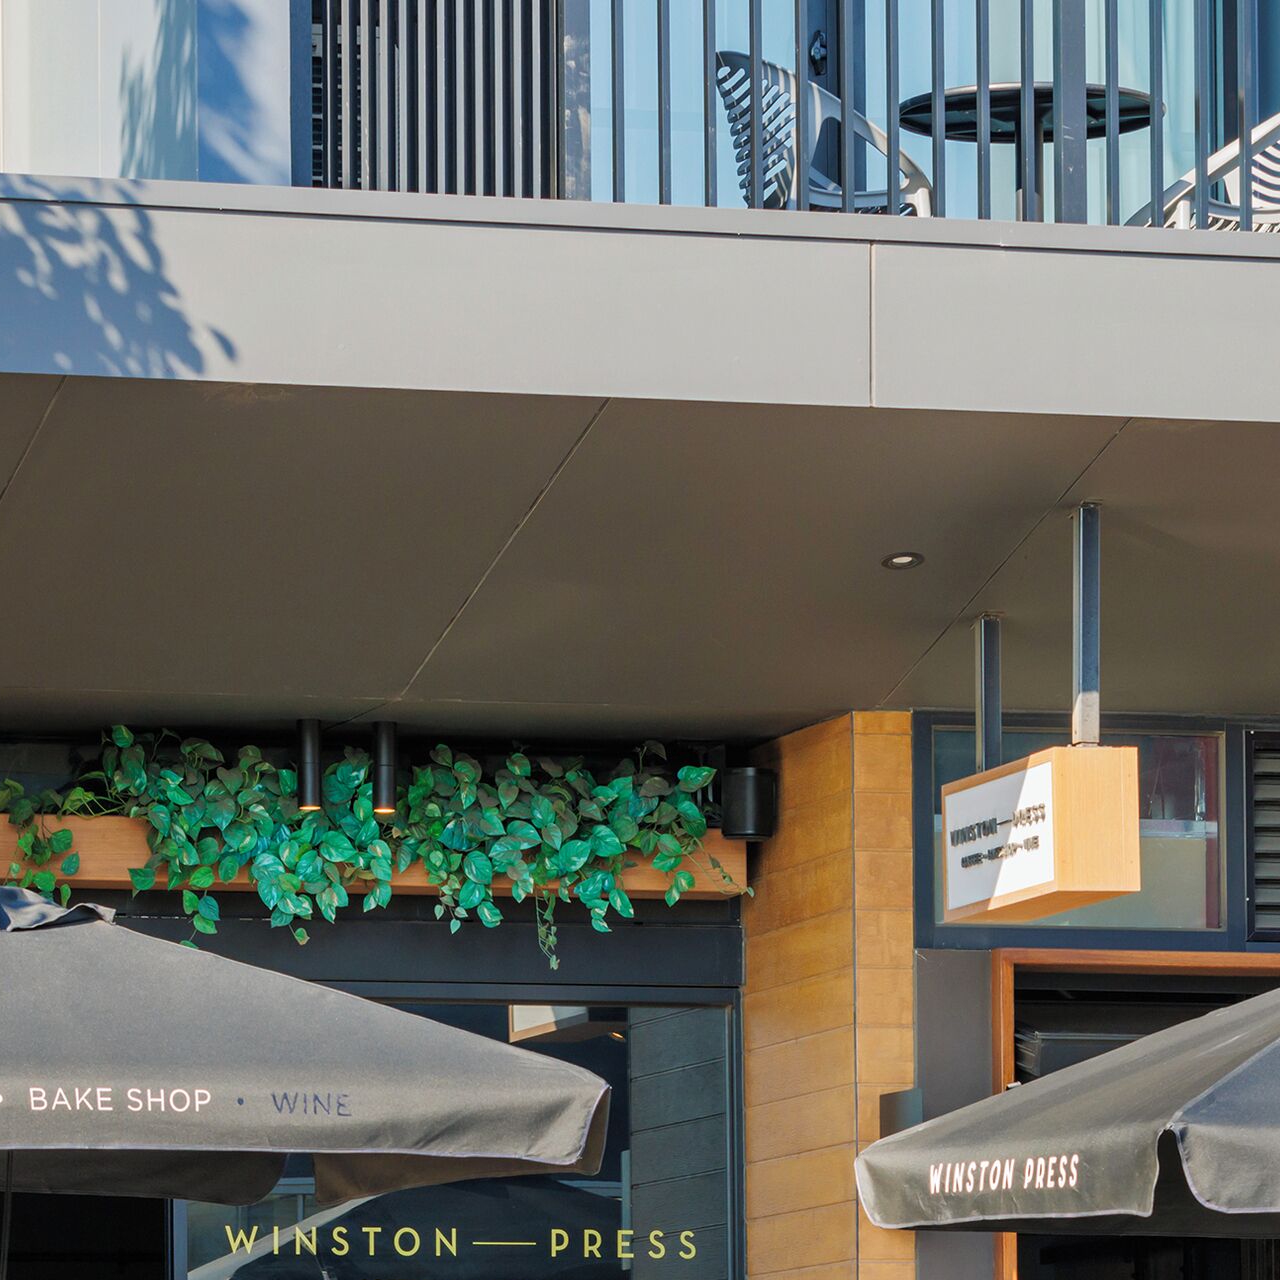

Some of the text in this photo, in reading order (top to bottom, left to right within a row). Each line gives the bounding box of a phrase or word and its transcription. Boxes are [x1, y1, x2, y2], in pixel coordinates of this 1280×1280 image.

[29, 1087, 114, 1111] BAKE
[126, 1087, 212, 1113] SHOP
[271, 1092, 352, 1117] WINE
[929, 1154, 1080, 1195] WINSTON PRESS
[224, 1225, 698, 1260] WINSTON PRESS
